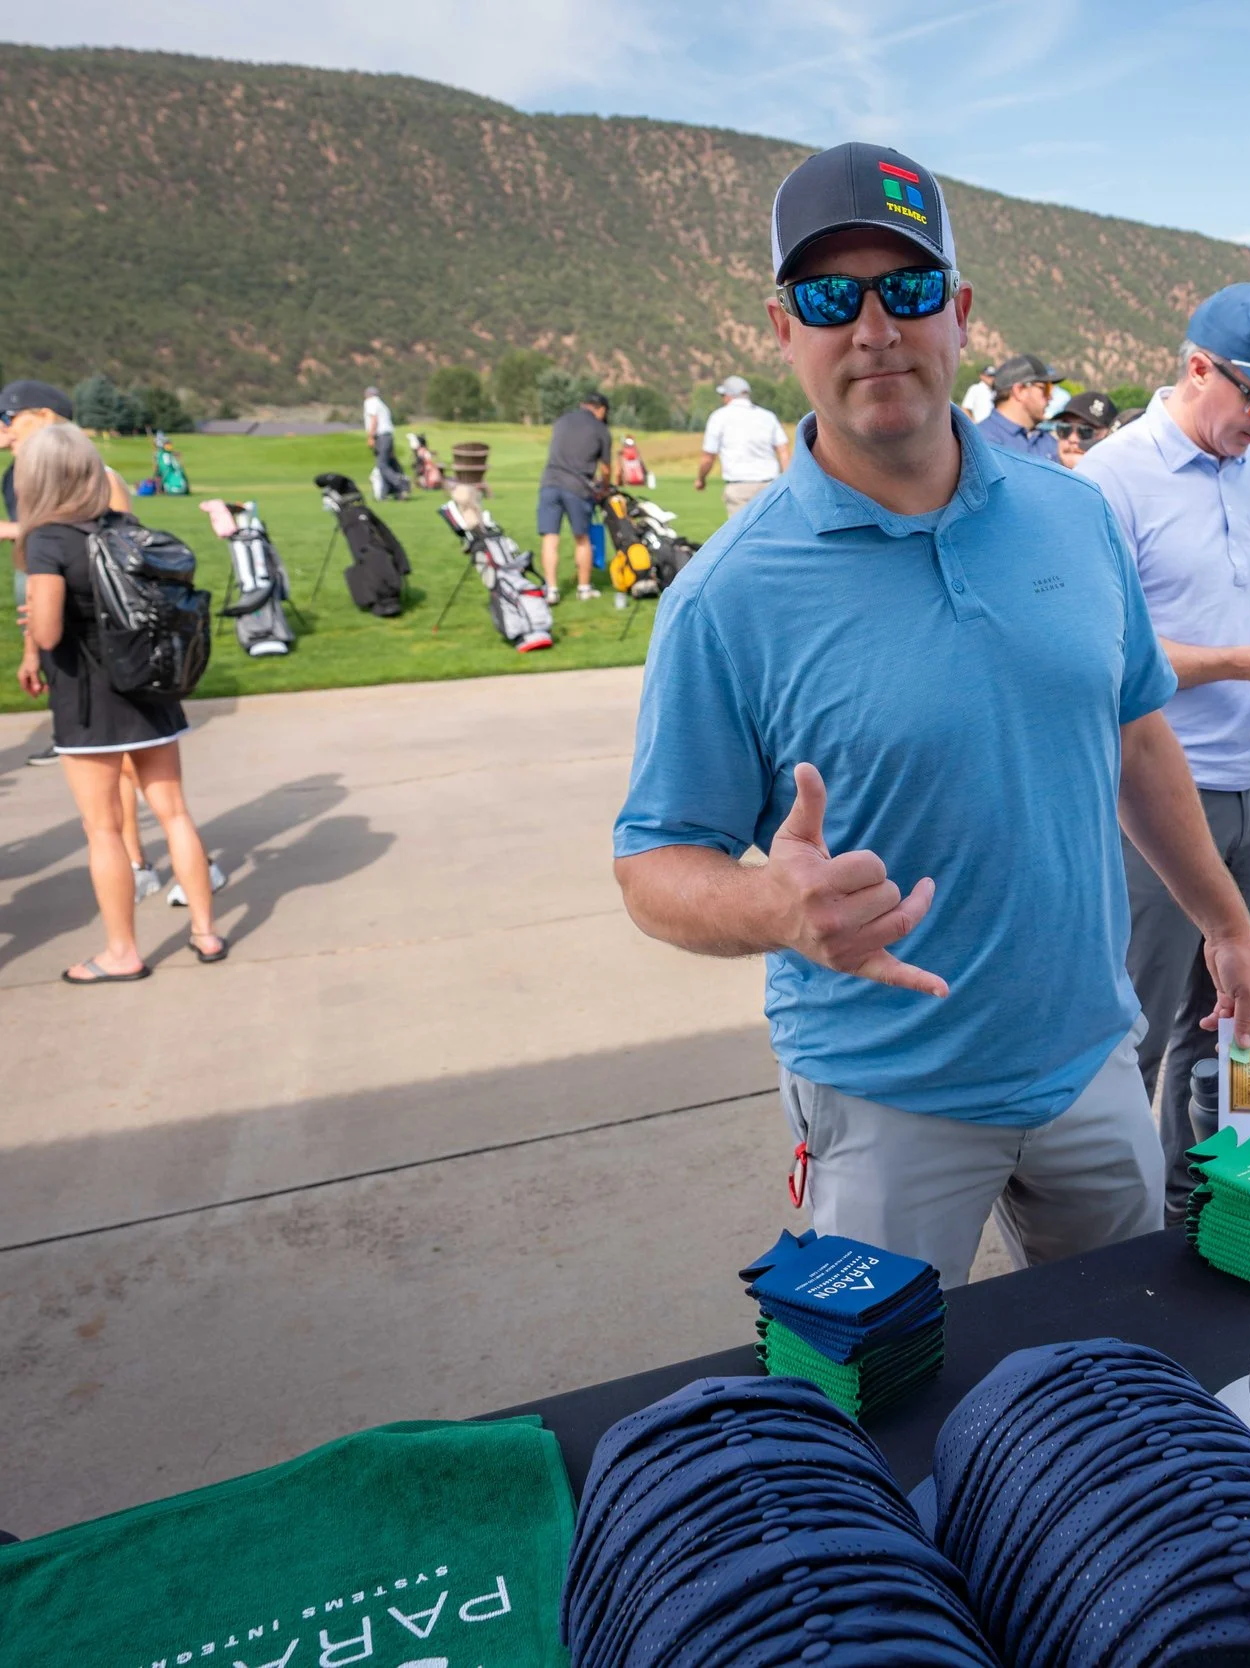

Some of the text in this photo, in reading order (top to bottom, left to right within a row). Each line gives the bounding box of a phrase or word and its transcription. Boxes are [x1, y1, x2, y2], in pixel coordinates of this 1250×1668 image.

[886, 202, 928, 225] TNEMEC
[813, 1256, 880, 1299] PARAGON
[302, 1566, 448, 1619] SYSTEMS
